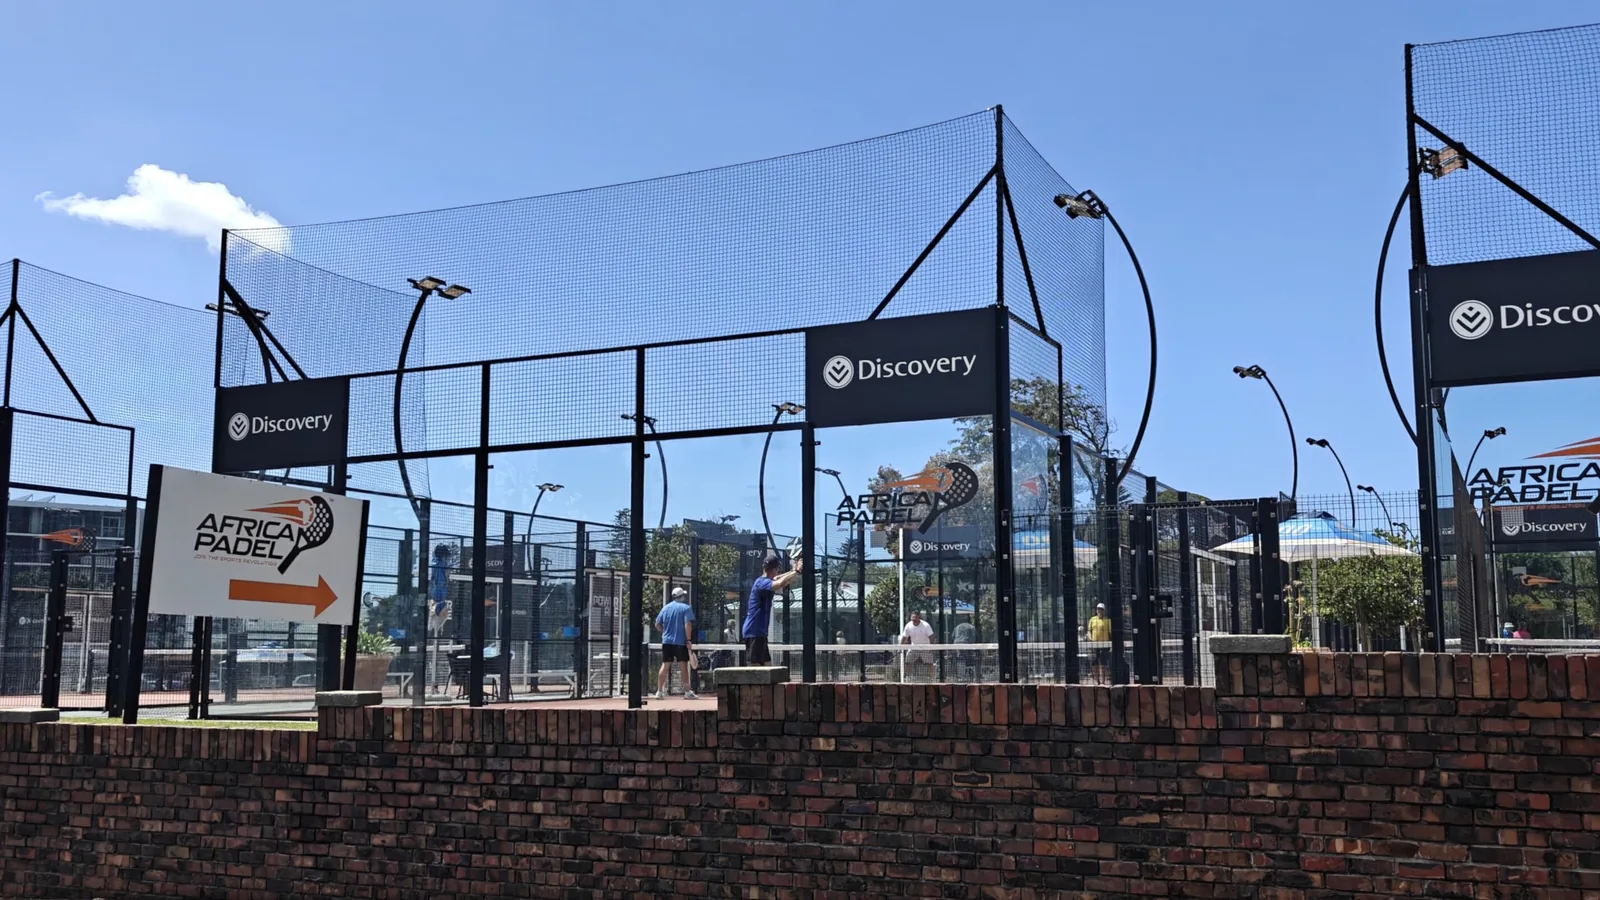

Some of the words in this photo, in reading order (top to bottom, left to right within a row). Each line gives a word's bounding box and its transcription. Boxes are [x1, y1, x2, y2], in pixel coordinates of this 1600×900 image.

[858, 354, 977, 380] Discovery
[252, 414, 333, 434] Discovery
[1468, 462, 1600, 486] AFRICA
[836, 491, 932, 510] AFRICA
[1470, 482, 1593, 504] PADEL
[196, 513, 294, 542] AFRICA
[836, 508, 922, 526] PADEL
[1522, 522, 1587, 533] Discovery
[194, 532, 283, 559] PADEL
[243, 559, 277, 568] REVOLUTION
